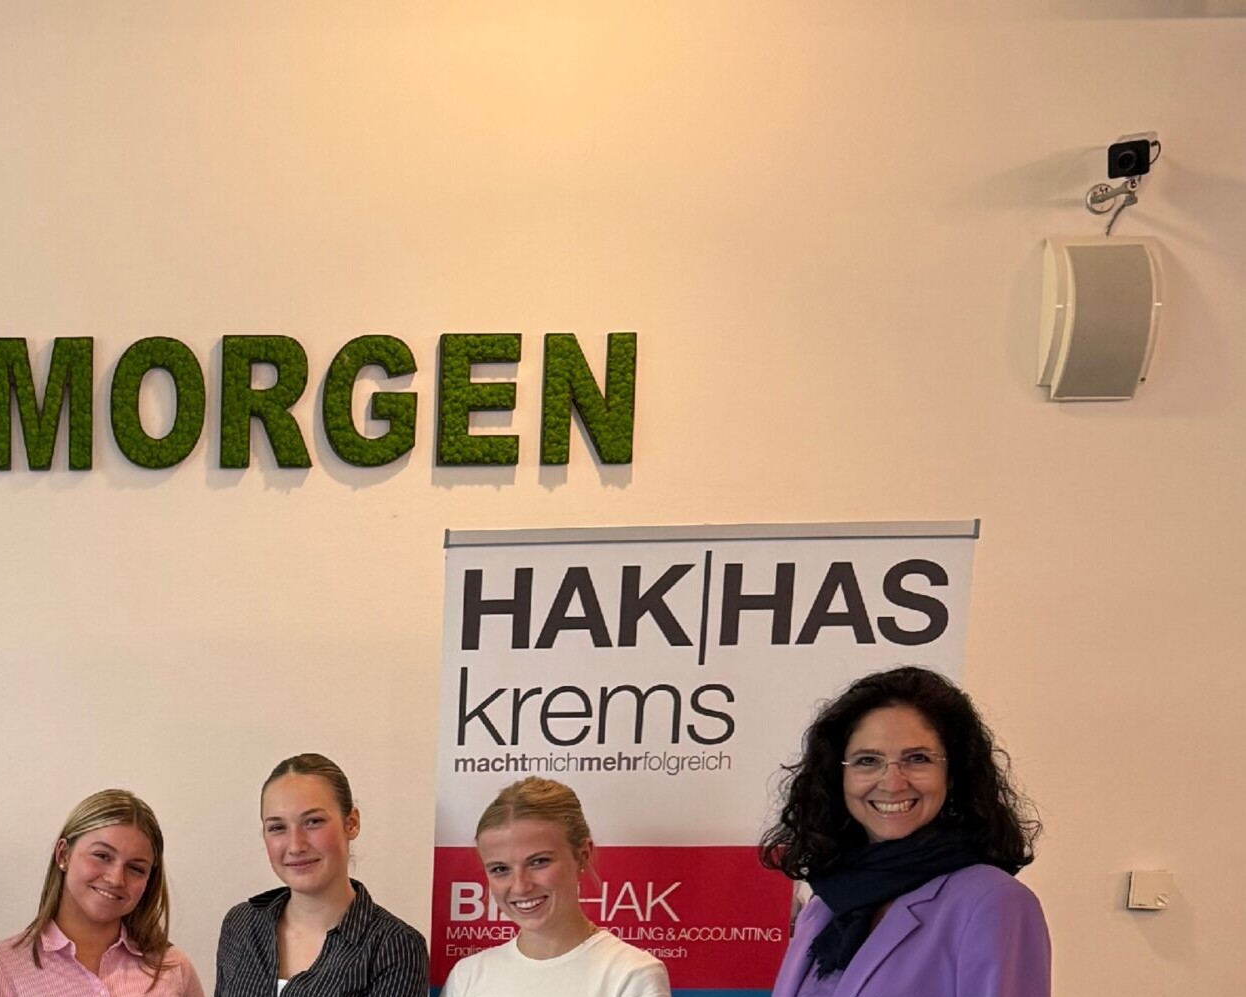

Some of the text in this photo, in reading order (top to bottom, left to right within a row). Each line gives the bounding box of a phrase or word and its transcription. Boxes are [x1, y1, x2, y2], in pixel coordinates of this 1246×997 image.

[457, 667, 735, 746] krems
[454, 751, 731, 776] machtmichmehrfolgreich
[450, 881, 512, 922] BI
[665, 928, 676, 941] &
[677, 927, 782, 942] ACCOUNTING
